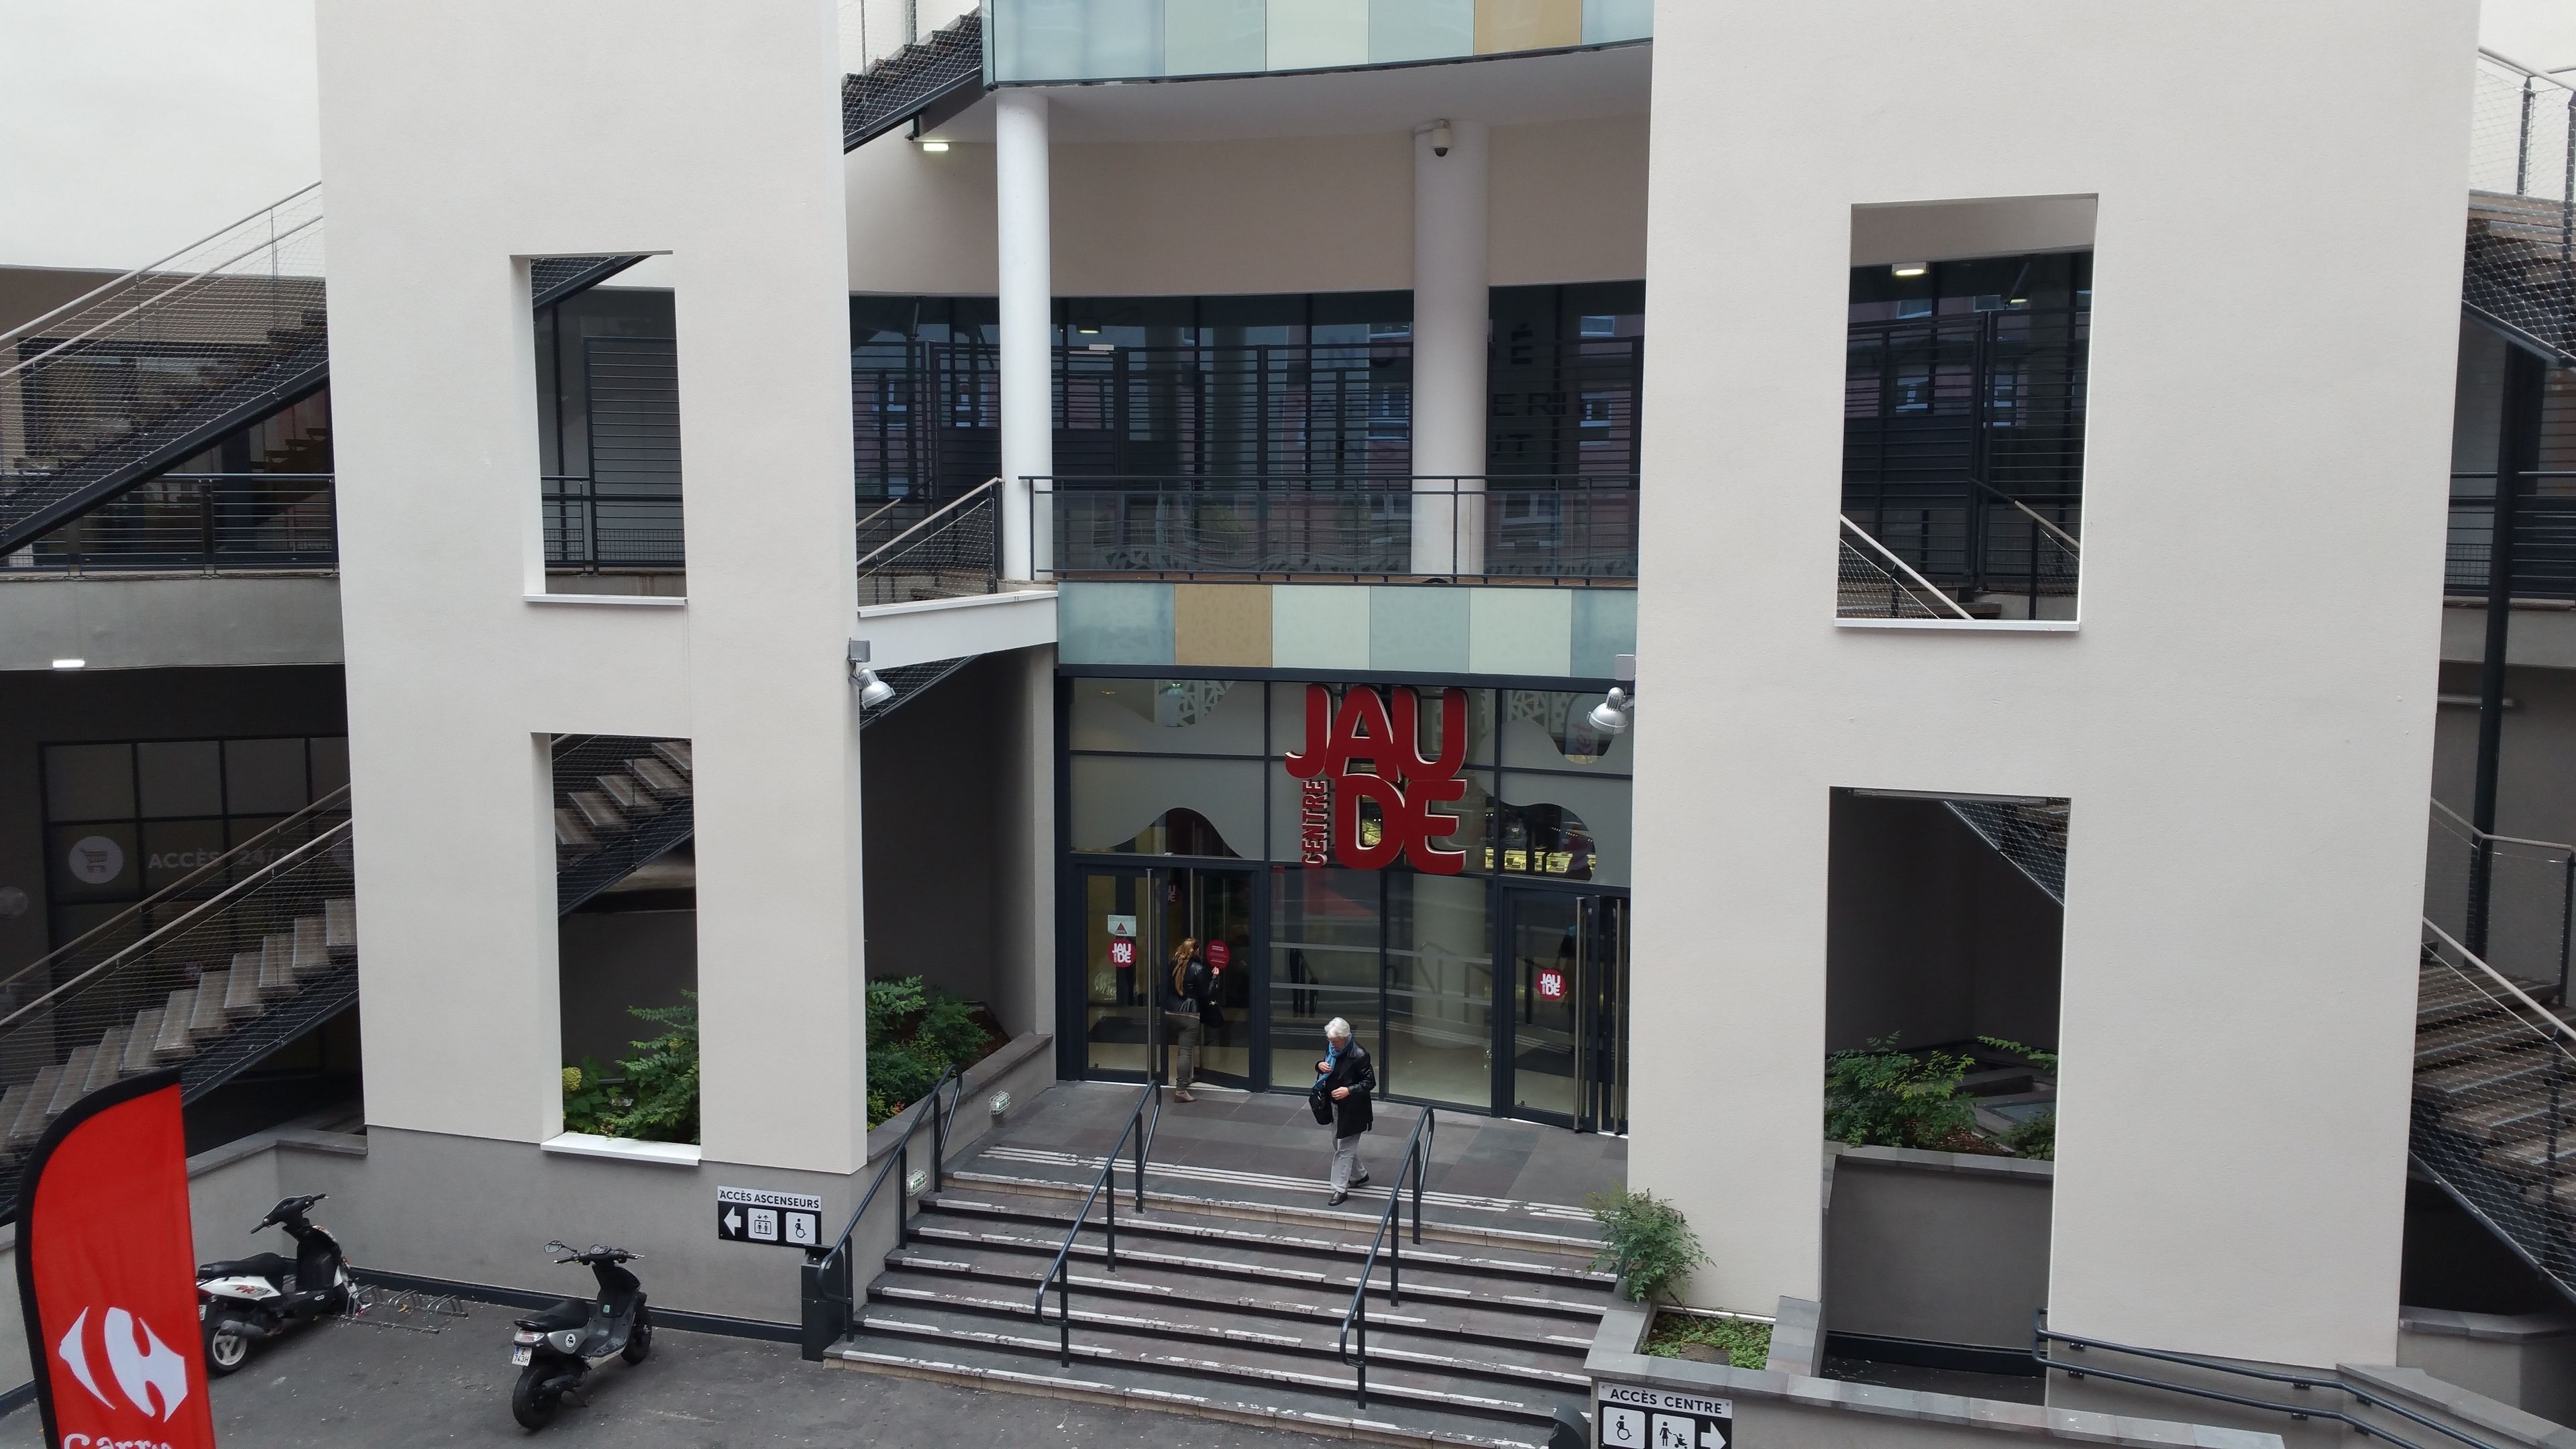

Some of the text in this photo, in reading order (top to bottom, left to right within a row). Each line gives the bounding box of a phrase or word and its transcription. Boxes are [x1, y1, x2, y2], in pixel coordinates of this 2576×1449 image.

[1285, 684, 1468, 780] JAU
[1301, 780, 1328, 867] CENTRE
[1334, 773, 1468, 875] DE
[720, 1190, 820, 1209] ACCÈS ASCENSEURS
[1610, 1389, 1723, 1414] ACCÈS CENTRE
